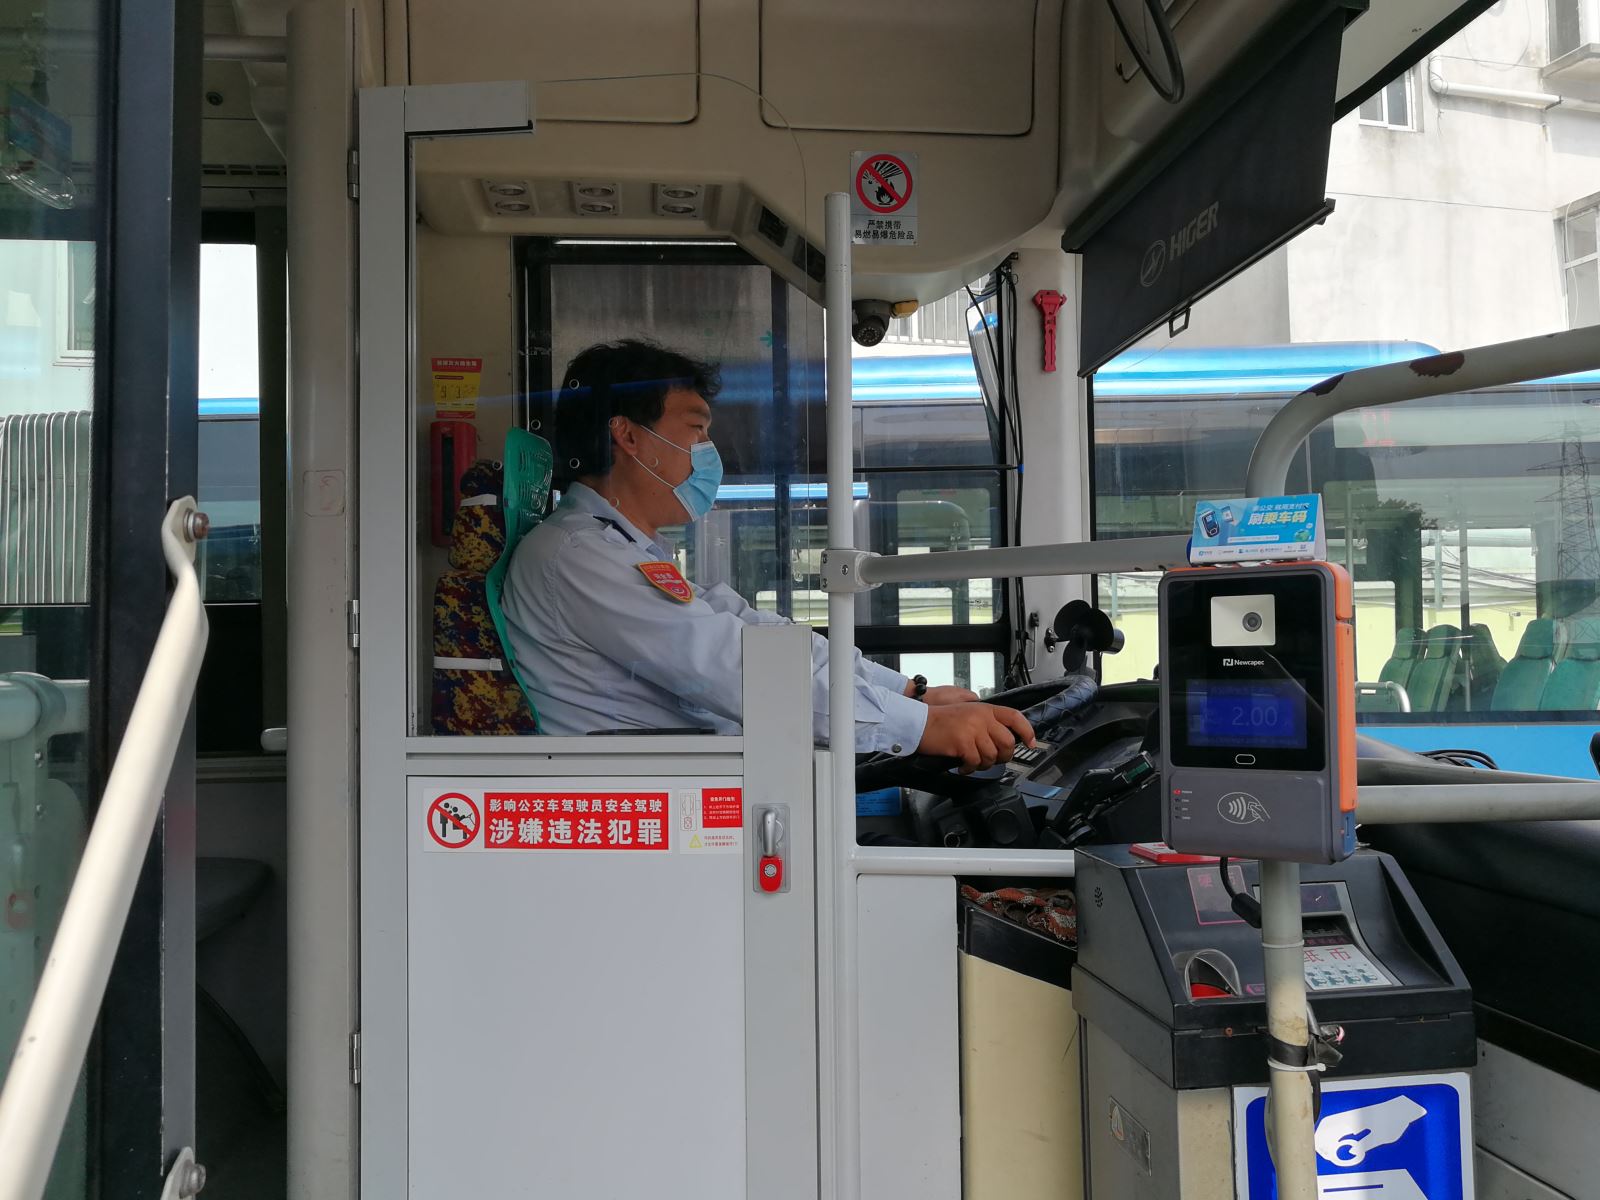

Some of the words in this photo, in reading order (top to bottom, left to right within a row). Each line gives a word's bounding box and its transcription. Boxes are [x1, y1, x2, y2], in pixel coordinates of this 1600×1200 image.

[867, 219, 901, 230] 严禁携带
[1169, 201, 1219, 261] HIGER
[855, 229, 915, 240] 易燃易爆危险品
[1248, 510, 1308, 525] 刷乘车码
[1234, 659, 1265, 667] Newcapec
[1231, 706, 1278, 727] 2.00
[489, 799, 662, 813] 影响公交车驾驶员安全驾驶
[489, 818, 662, 845] 涉嫌违法犯罪
